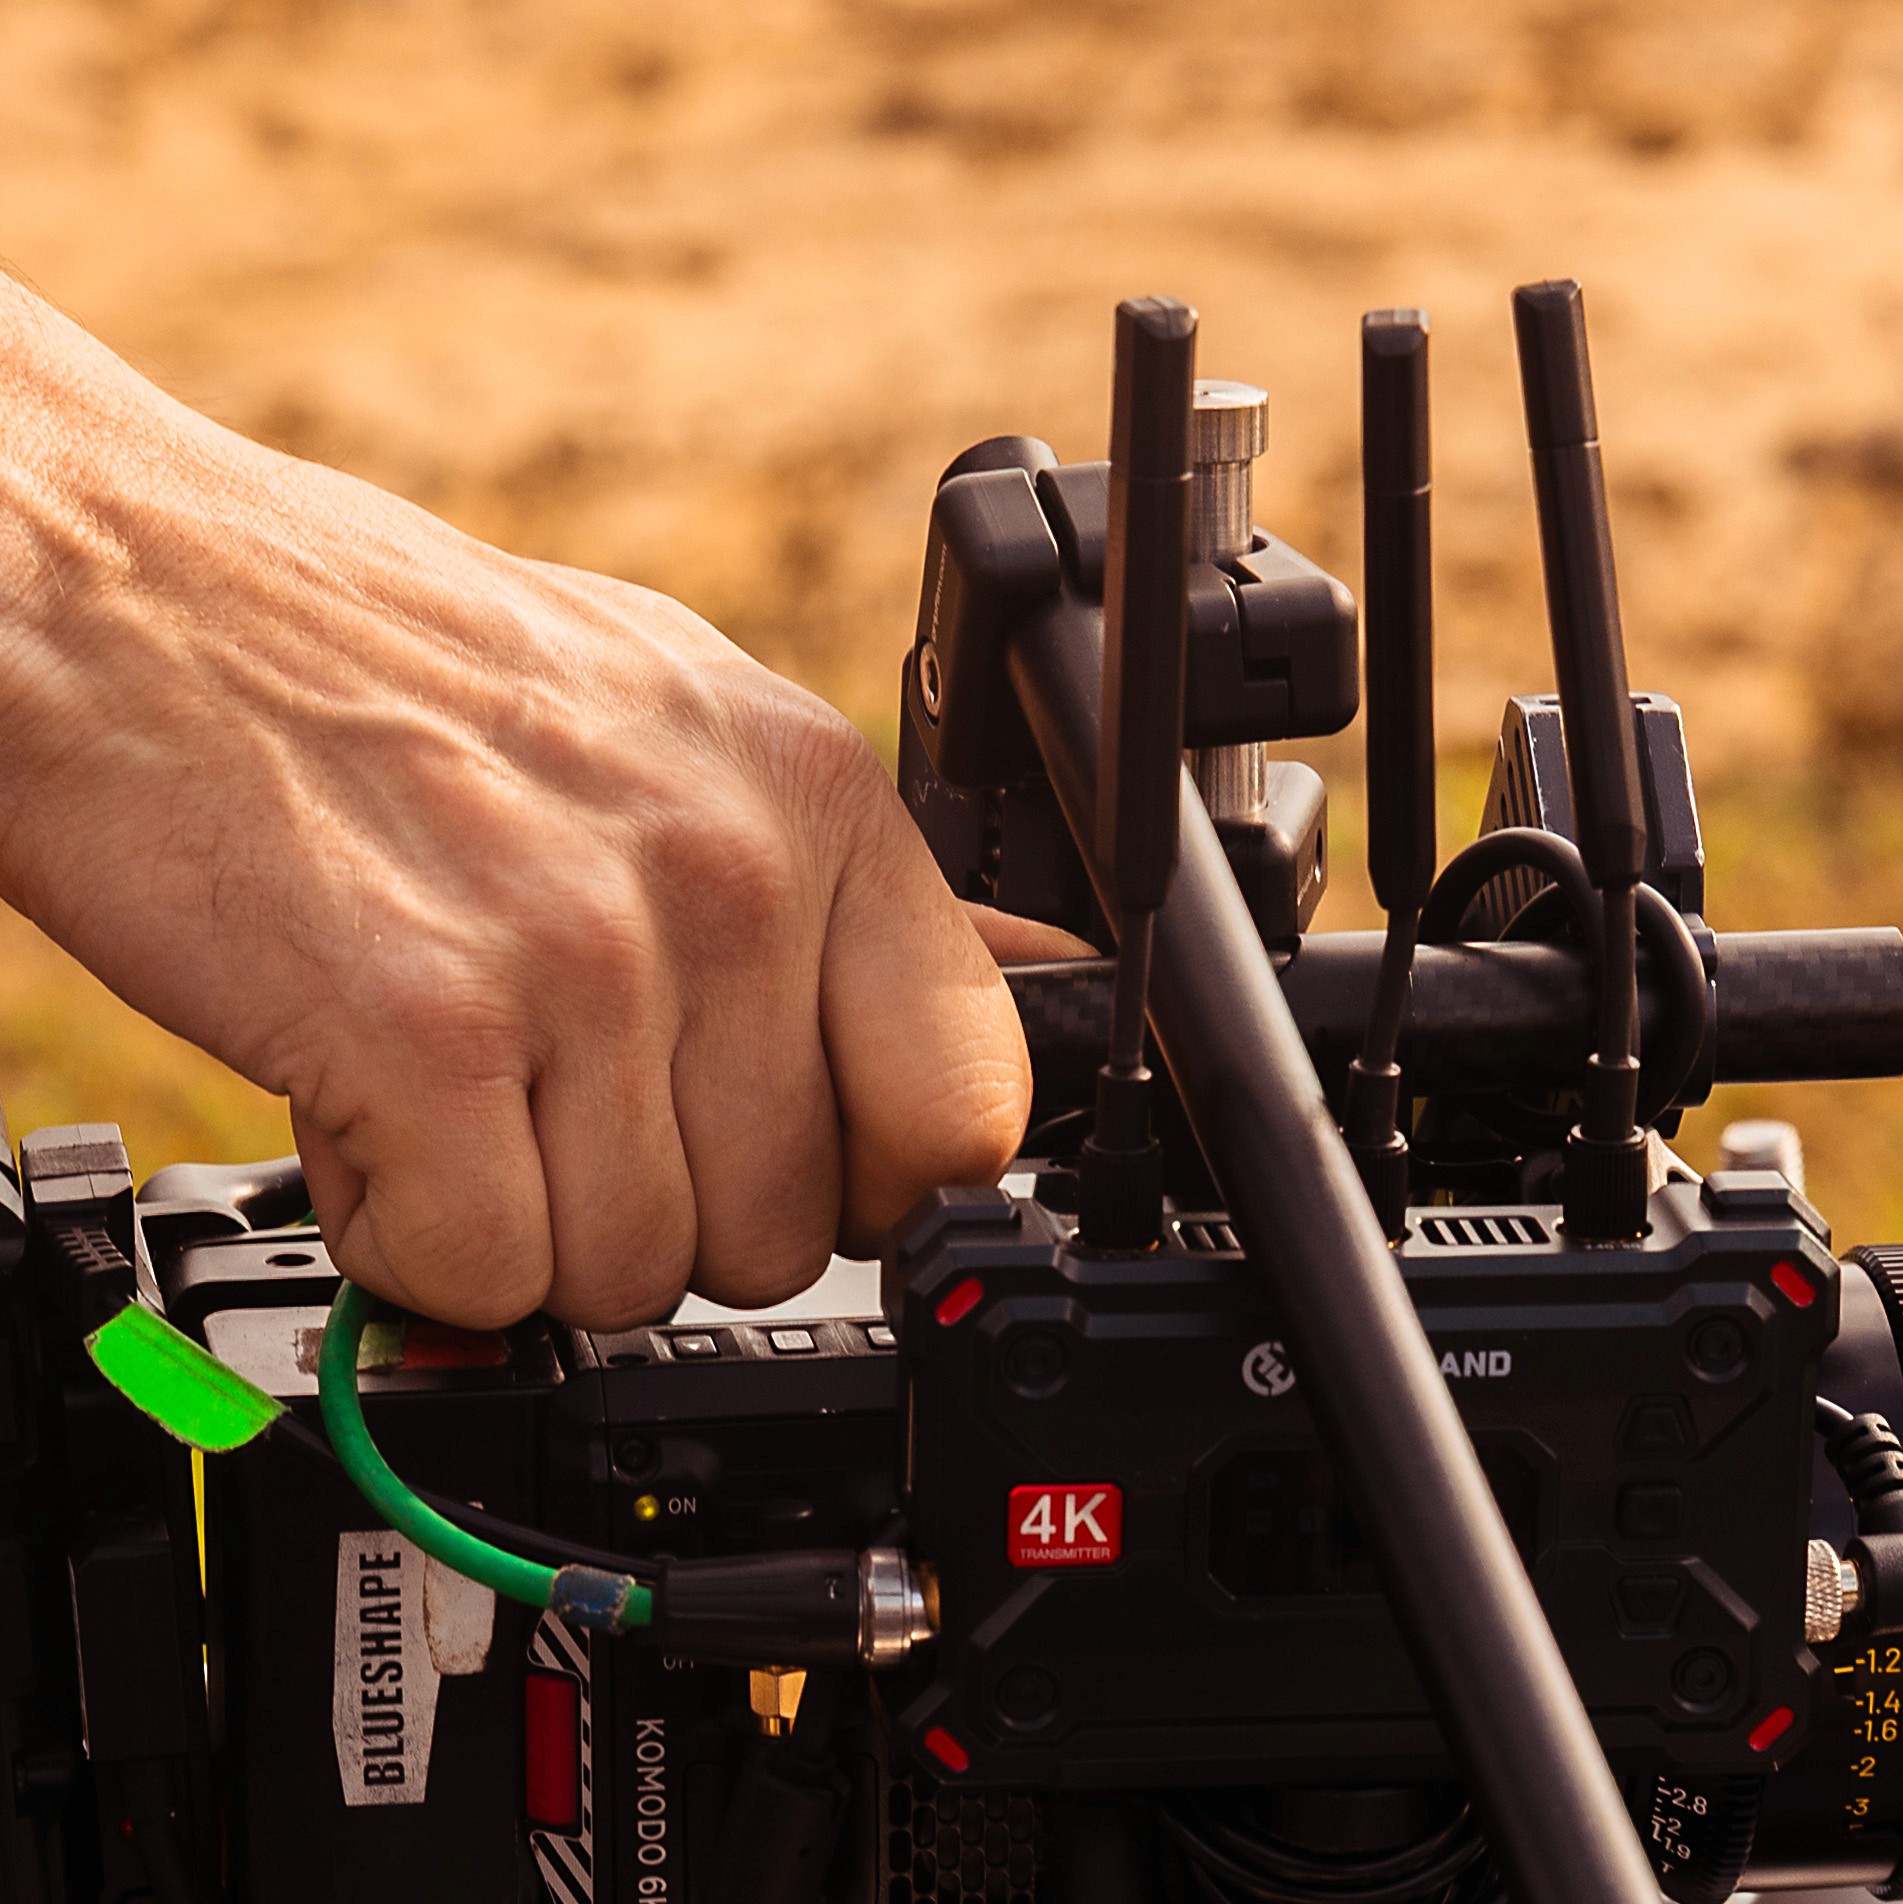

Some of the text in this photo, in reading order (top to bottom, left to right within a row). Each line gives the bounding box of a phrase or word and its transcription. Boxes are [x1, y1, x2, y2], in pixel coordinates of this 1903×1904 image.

[668, 1497, 697, 1515] ON
[1019, 1493, 1108, 1544] 4K
[1019, 1547, 1111, 1561] TRANSMITTER
[358, 1550, 406, 1790] BLUESHAPE
[635, 1717, 669, 1868] KOMODO
